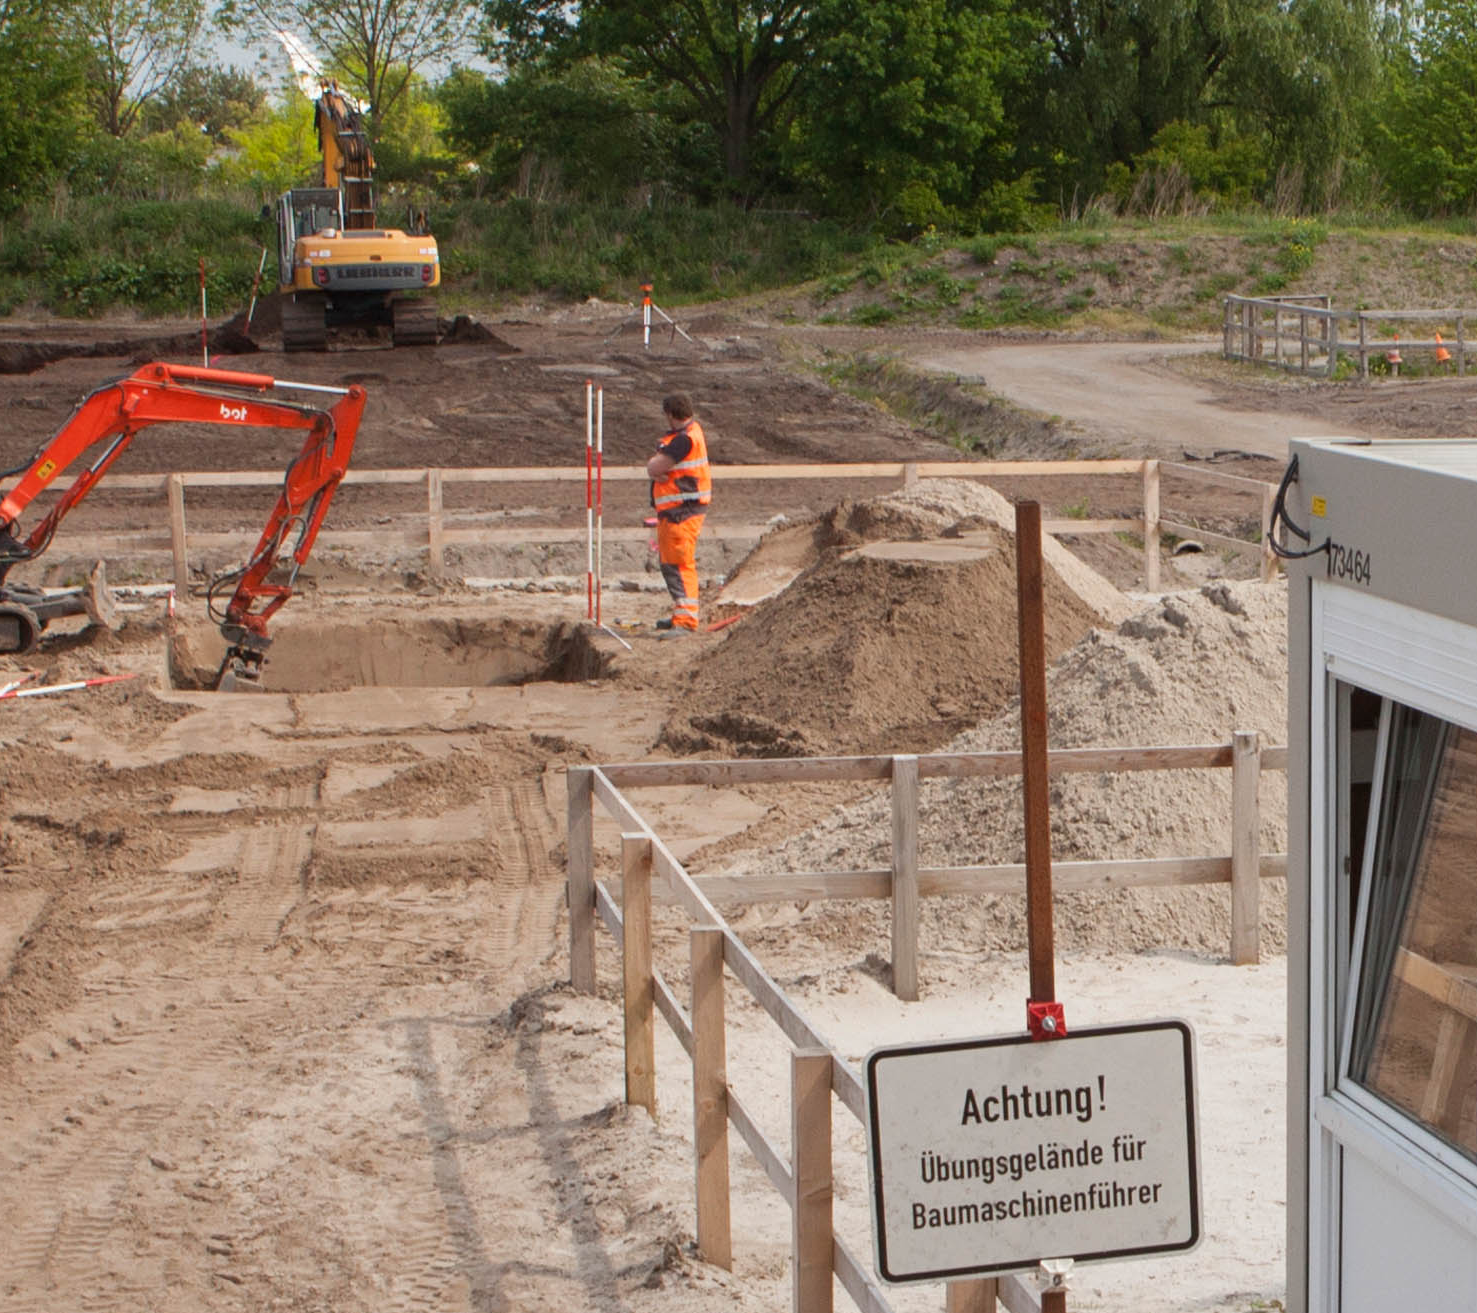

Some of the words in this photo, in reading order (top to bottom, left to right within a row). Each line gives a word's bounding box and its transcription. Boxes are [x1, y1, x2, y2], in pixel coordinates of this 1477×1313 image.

[961, 1075, 1106, 1126] Achtung!
[920, 1138, 1104, 1185] Übungsgelände
[1112, 1134, 1147, 1163] für
[911, 1180, 1163, 1230] Baumaschinenführer
